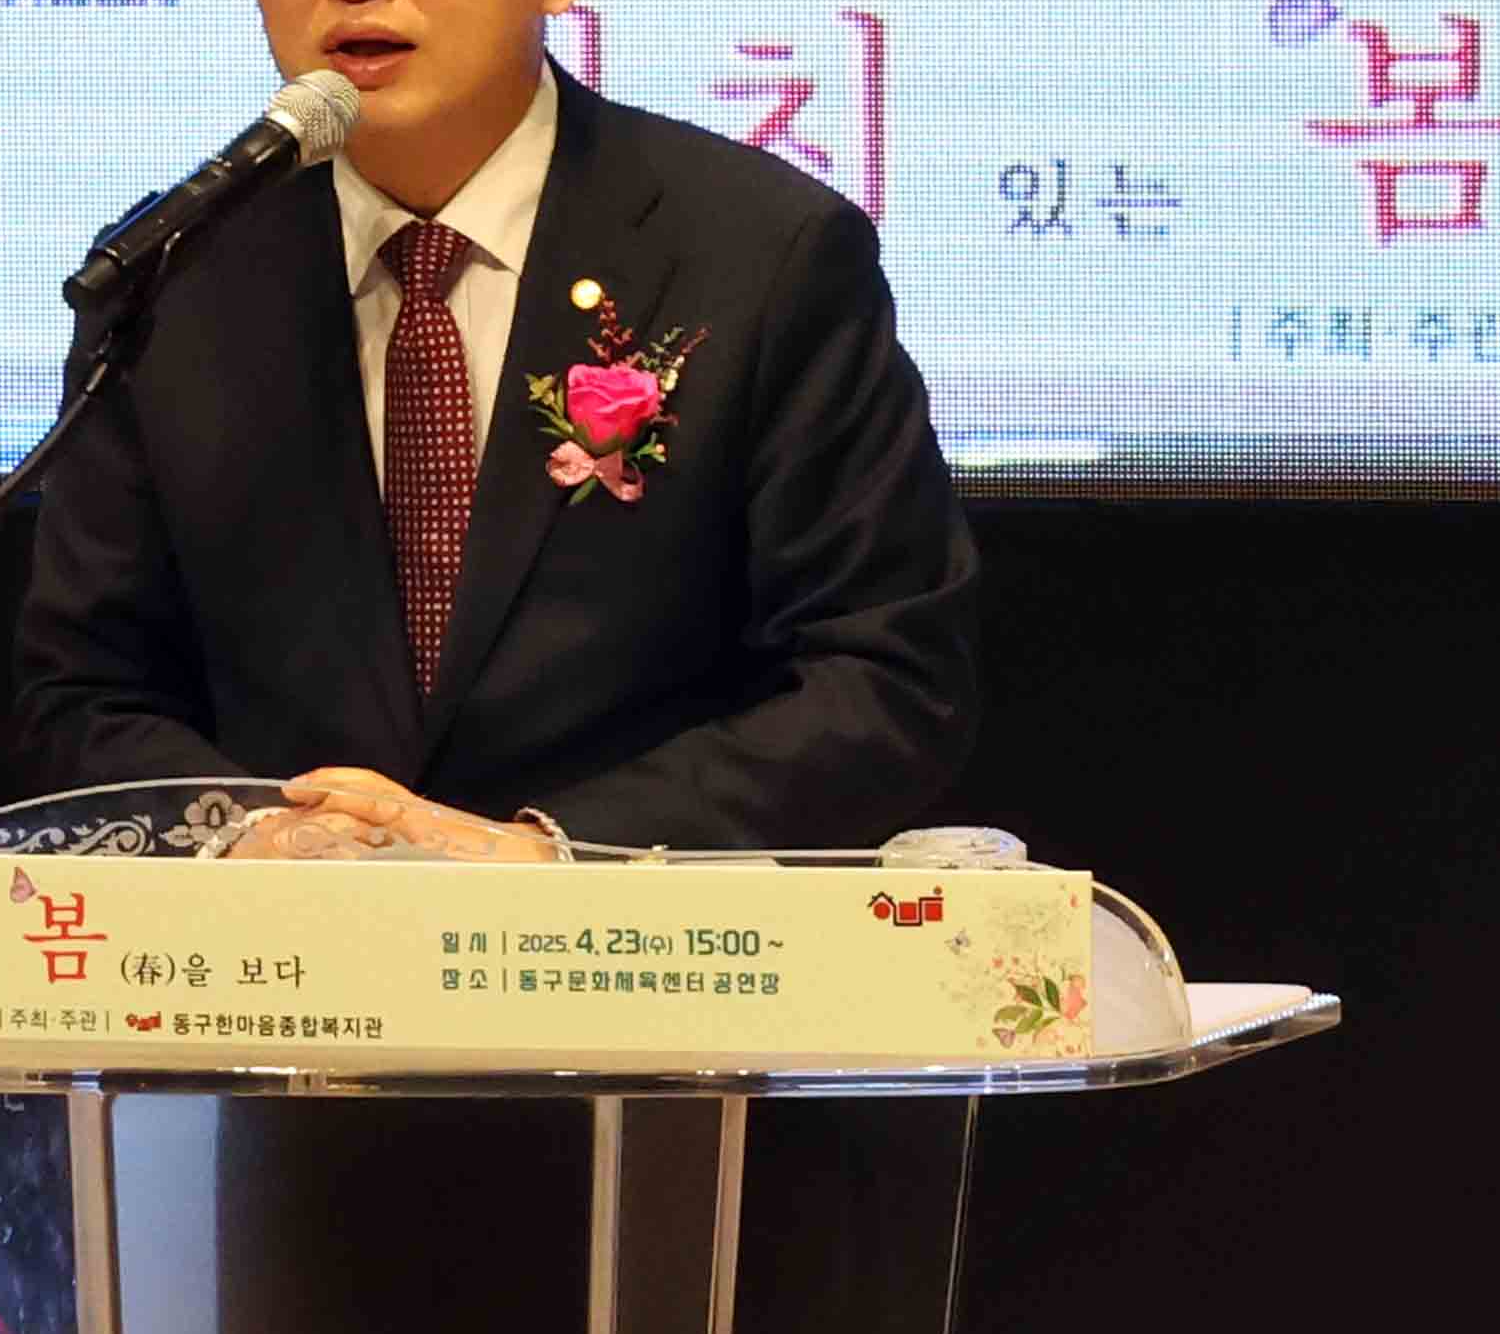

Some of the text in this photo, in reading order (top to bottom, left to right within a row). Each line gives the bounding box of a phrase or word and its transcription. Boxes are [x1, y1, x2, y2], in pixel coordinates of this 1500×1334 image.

[1000, 160, 1184, 237] 있는
[23, 892, 108, 984] 봄
[237, 955, 306, 989] 보다
[684, 928, 760, 956] 15:00
[713, 971, 781, 995] 공연장
[172, 1012, 384, 1039] 동구한마음종합복지관
